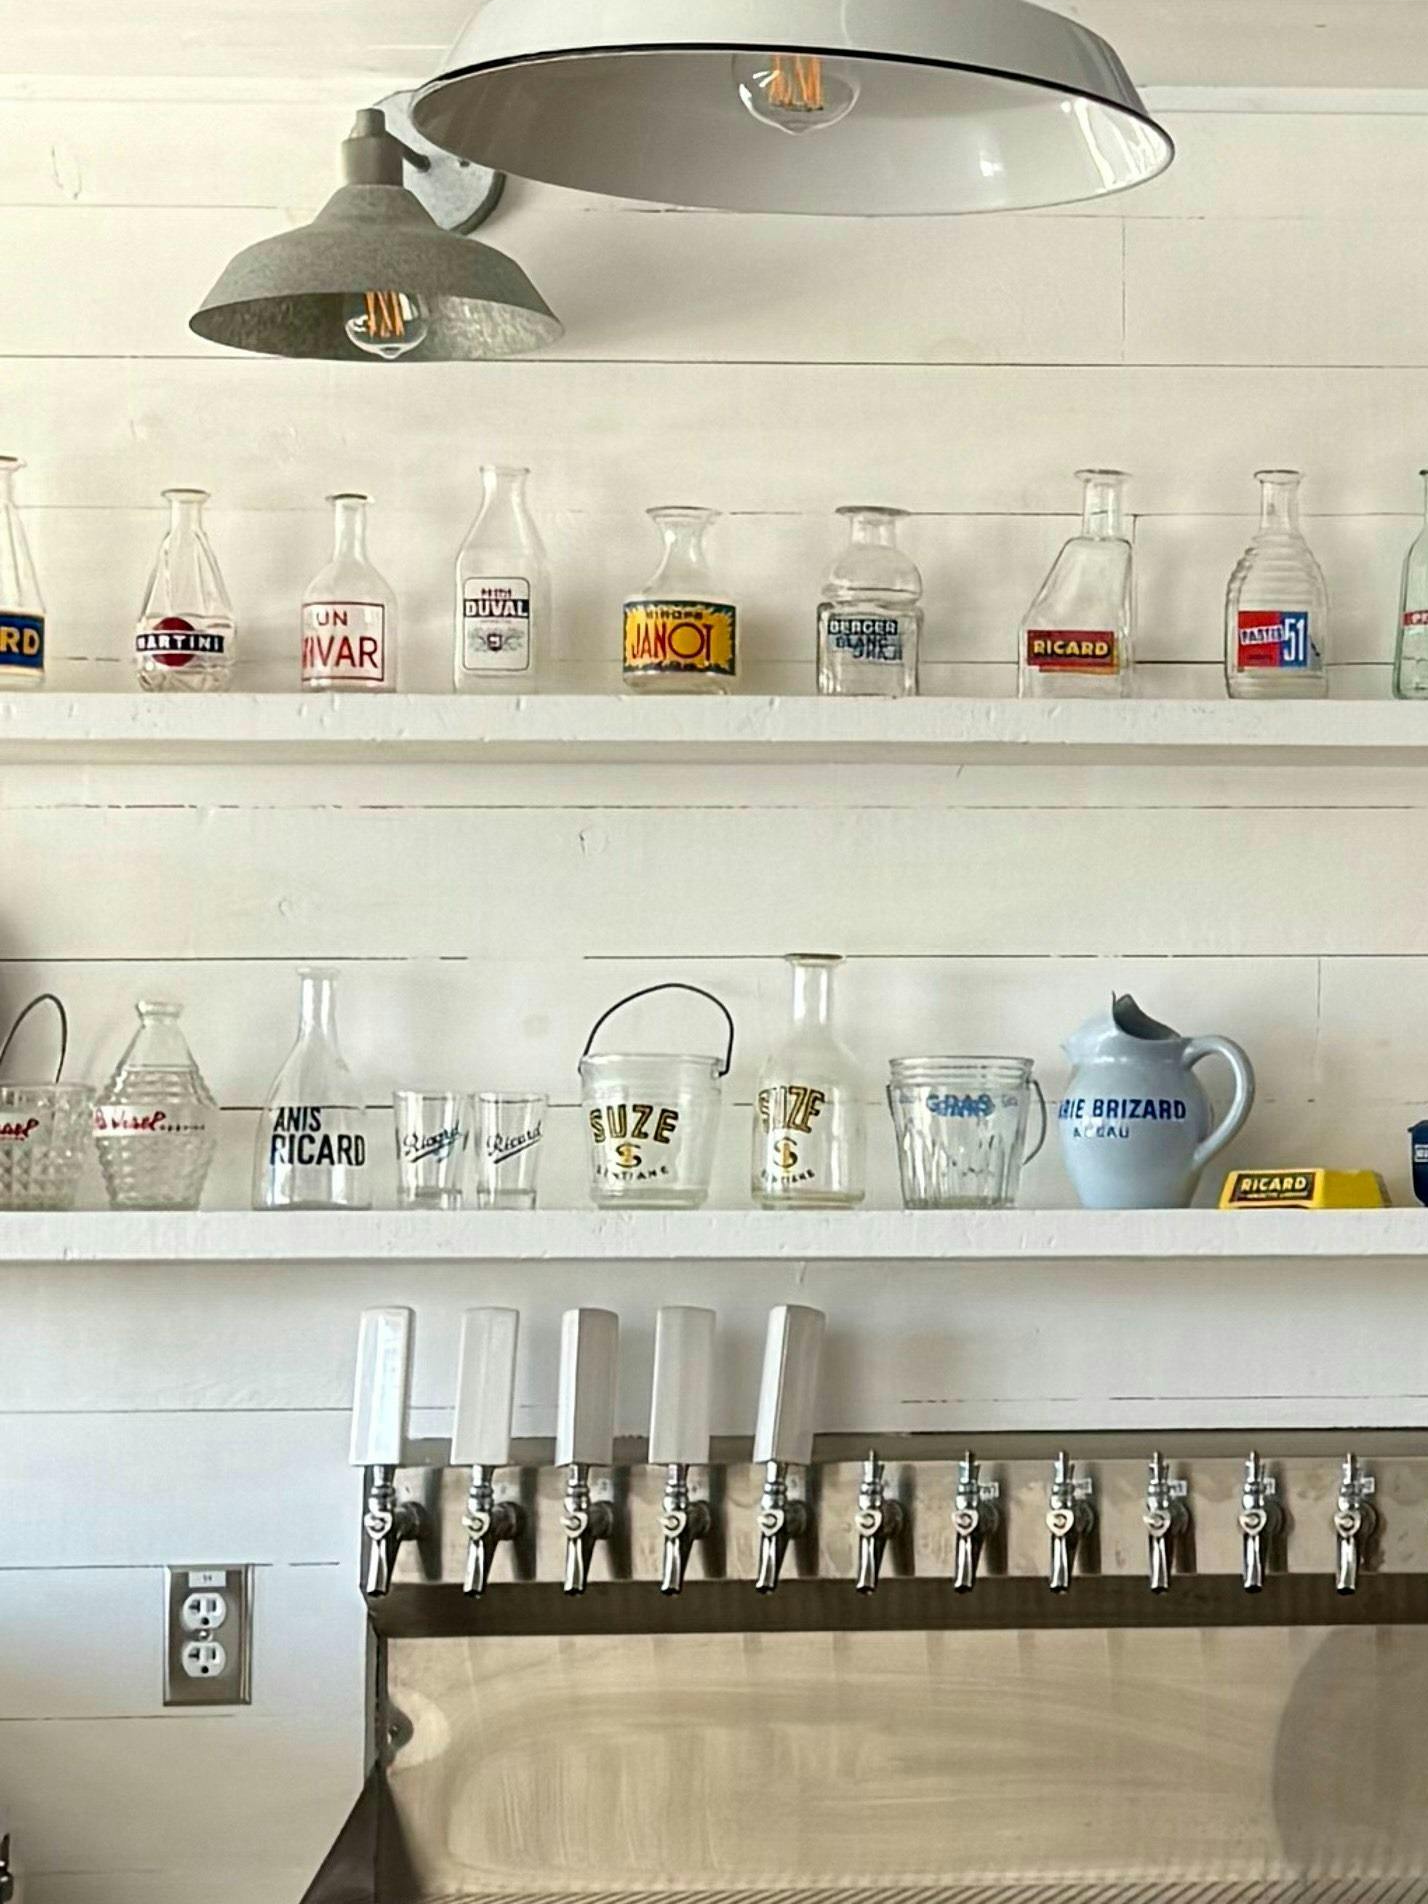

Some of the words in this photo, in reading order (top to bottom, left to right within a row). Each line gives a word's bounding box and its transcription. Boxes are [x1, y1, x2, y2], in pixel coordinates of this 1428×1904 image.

[316, 610, 348, 626] UN
[466, 600, 529, 617] DUVAL
[138, 634, 220, 652] MARTINI
[631, 621, 714, 662] JANOT
[1033, 639, 1109, 657] RICARD
[1283, 618, 1305, 662] 51
[273, 1106, 322, 1133] ANIS
[1092, 1098, 1186, 1120] BRIZARD
[589, 1103, 680, 1145] SUZE
[270, 1133, 366, 1166] RICARD
[486, 1119, 543, 1160] Ricard
[1240, 1176, 1308, 1192] RICARD
